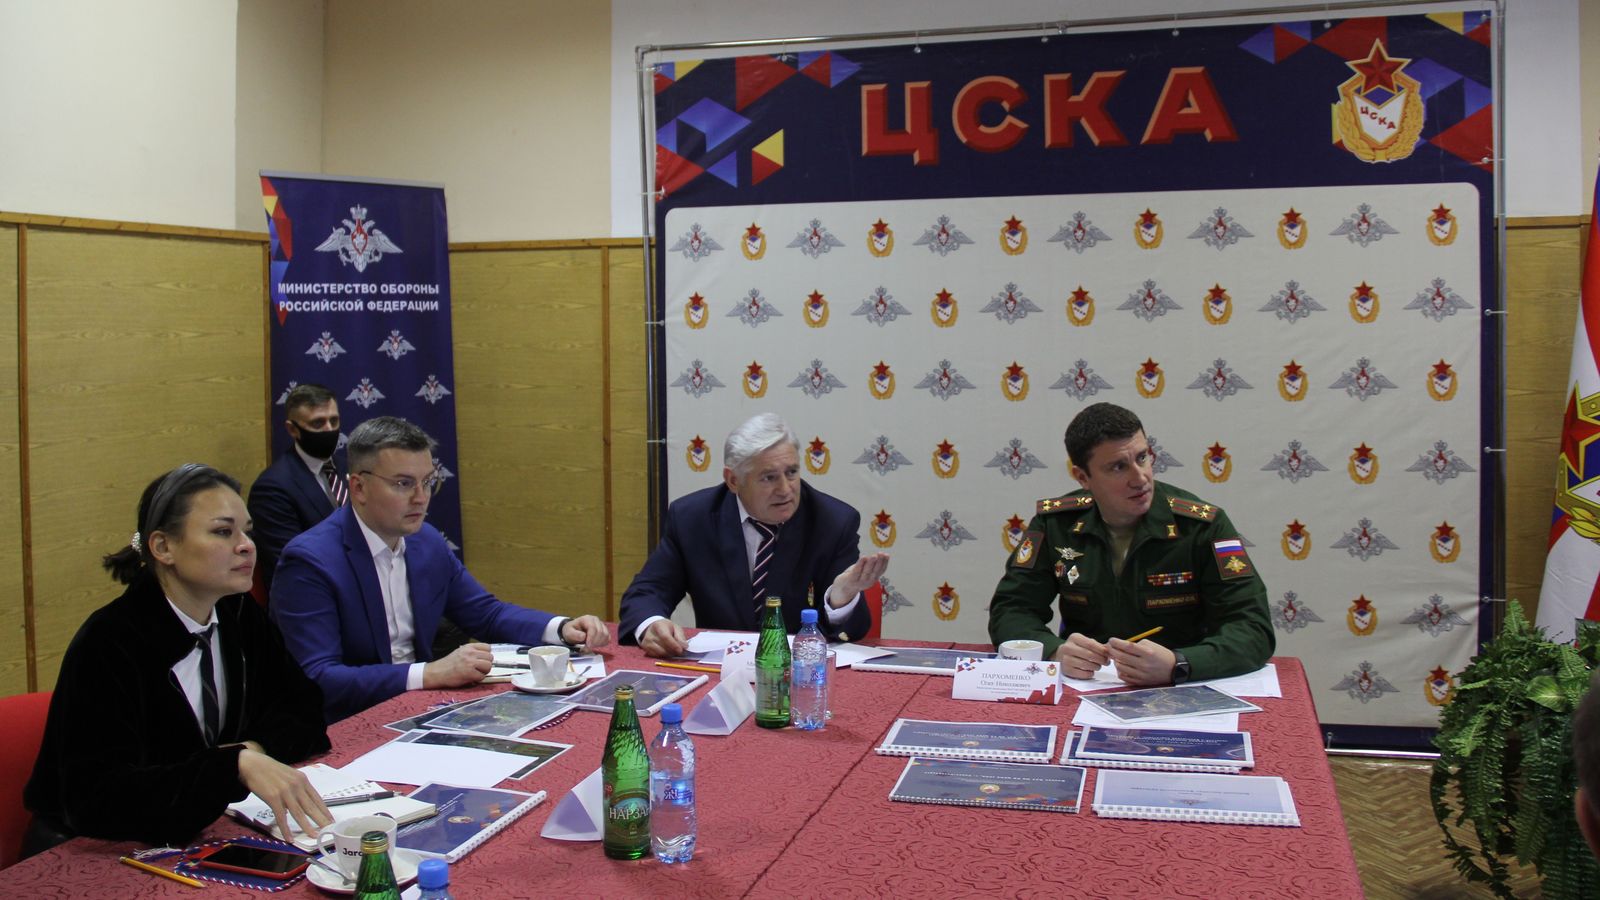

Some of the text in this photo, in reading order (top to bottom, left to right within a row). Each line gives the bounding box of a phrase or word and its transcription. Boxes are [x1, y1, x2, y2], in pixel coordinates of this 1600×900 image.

[861, 66, 1239, 166] ЦСКА
[1360, 106, 1396, 129] ЦСКА
[278, 283, 439, 295] МИНИСТЕРСТВО ОБОРОНЫ
[279, 299, 439, 312] РОССИЙСКОЙ ФЕДЕРАЦИИ
[981, 672, 1031, 681] ПАРХОМЕНКО
